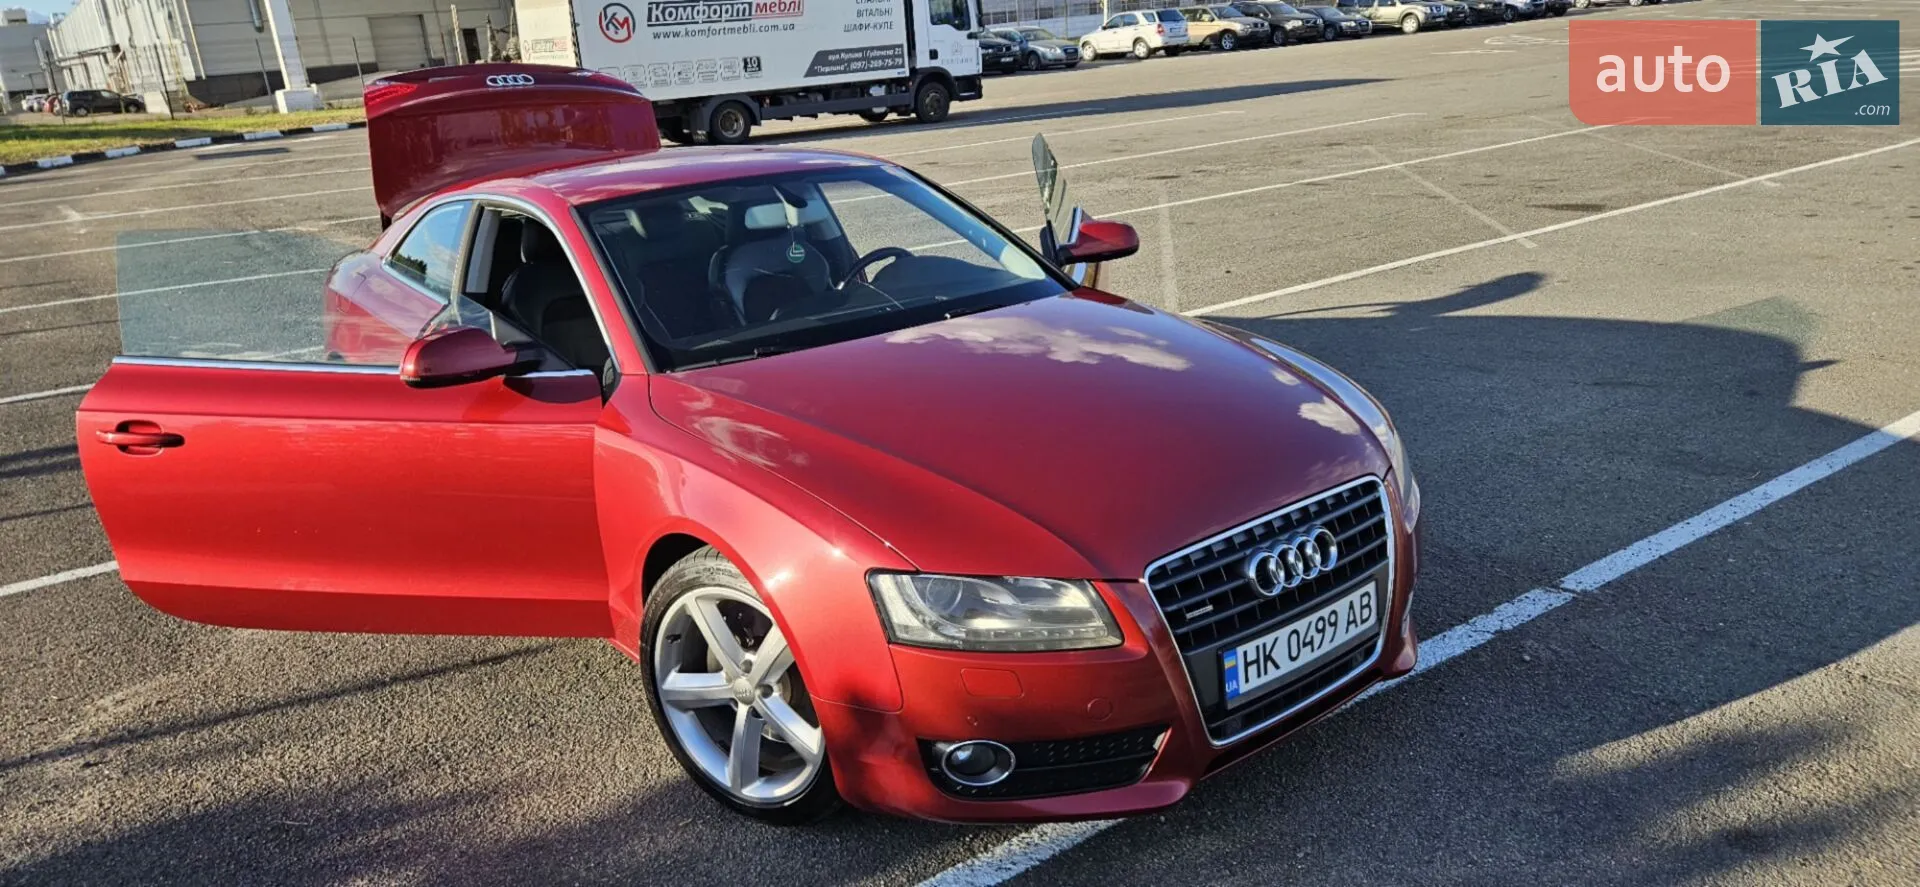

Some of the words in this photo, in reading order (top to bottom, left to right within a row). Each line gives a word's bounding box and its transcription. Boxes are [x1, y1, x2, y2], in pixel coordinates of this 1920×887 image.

[651, 1, 750, 23] Комфорт
[653, 23, 795, 39] www.komfortmebli.com.ua
[844, 21, 894, 33] ШАФИ-КУПЕ
[1243, 637, 1282, 684] HK
[1287, 609, 1339, 662] 0499
[1344, 591, 1373, 635] AB
[1225, 680, 1238, 692] UA
